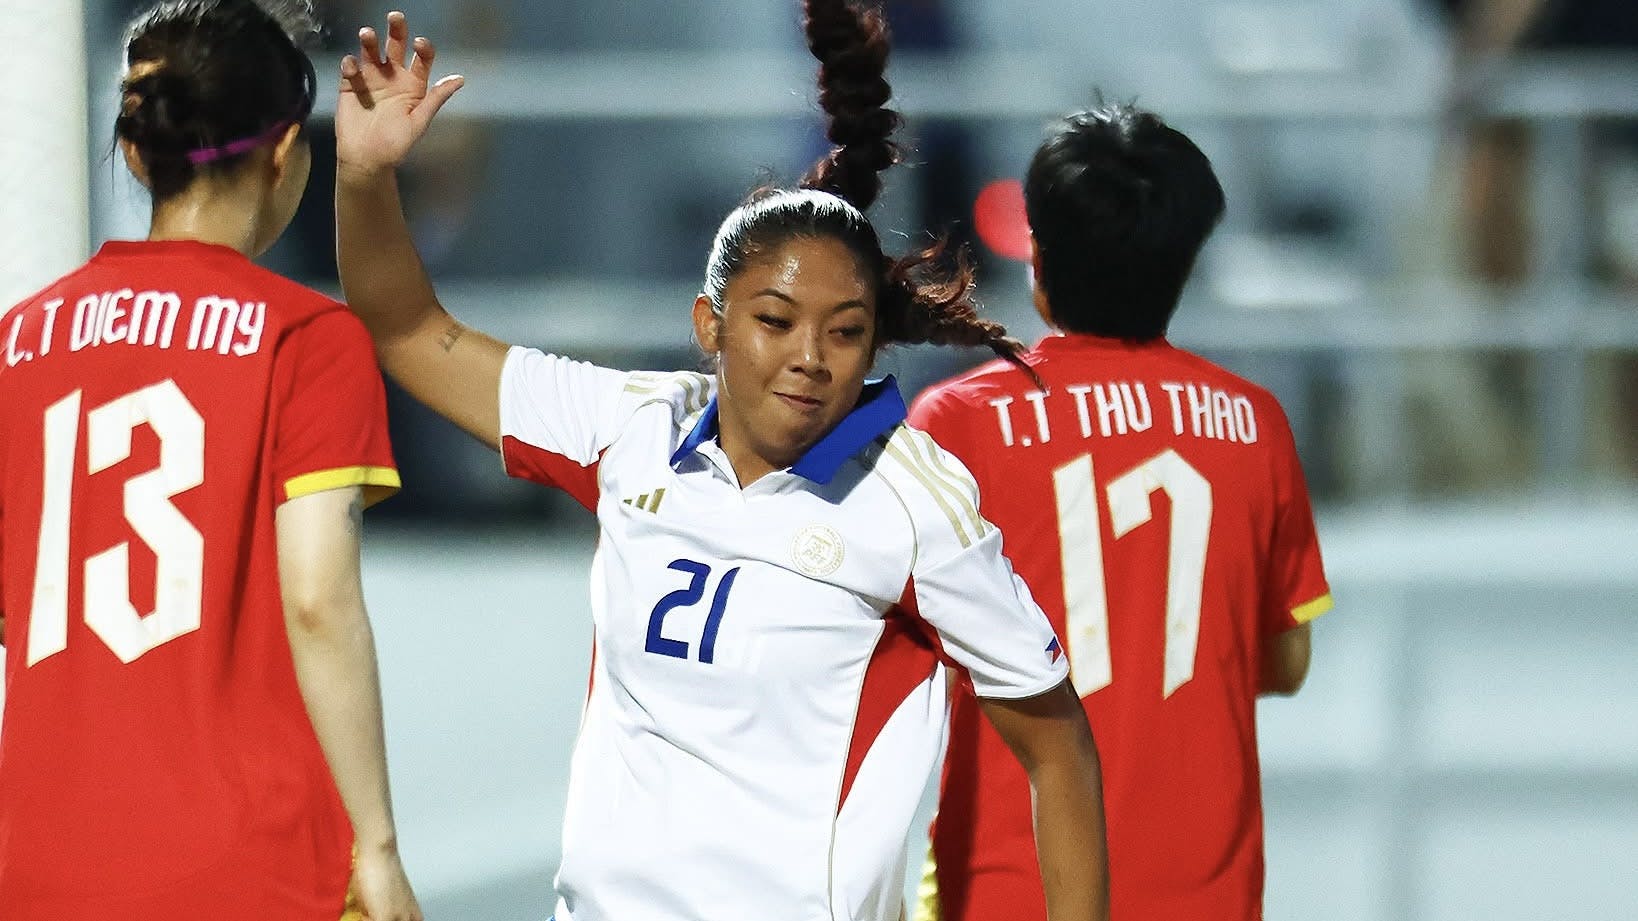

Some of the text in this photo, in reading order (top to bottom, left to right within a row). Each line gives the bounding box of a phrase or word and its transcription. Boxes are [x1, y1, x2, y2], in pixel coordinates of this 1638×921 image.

[6, 299, 64, 367] L.T
[69, 287, 183, 353] DIEM
[989, 382, 1257, 447] T.T THU THAO
[27, 378, 205, 668] 13
[1053, 448, 1213, 700] 17
[645, 558, 740, 664] 21
